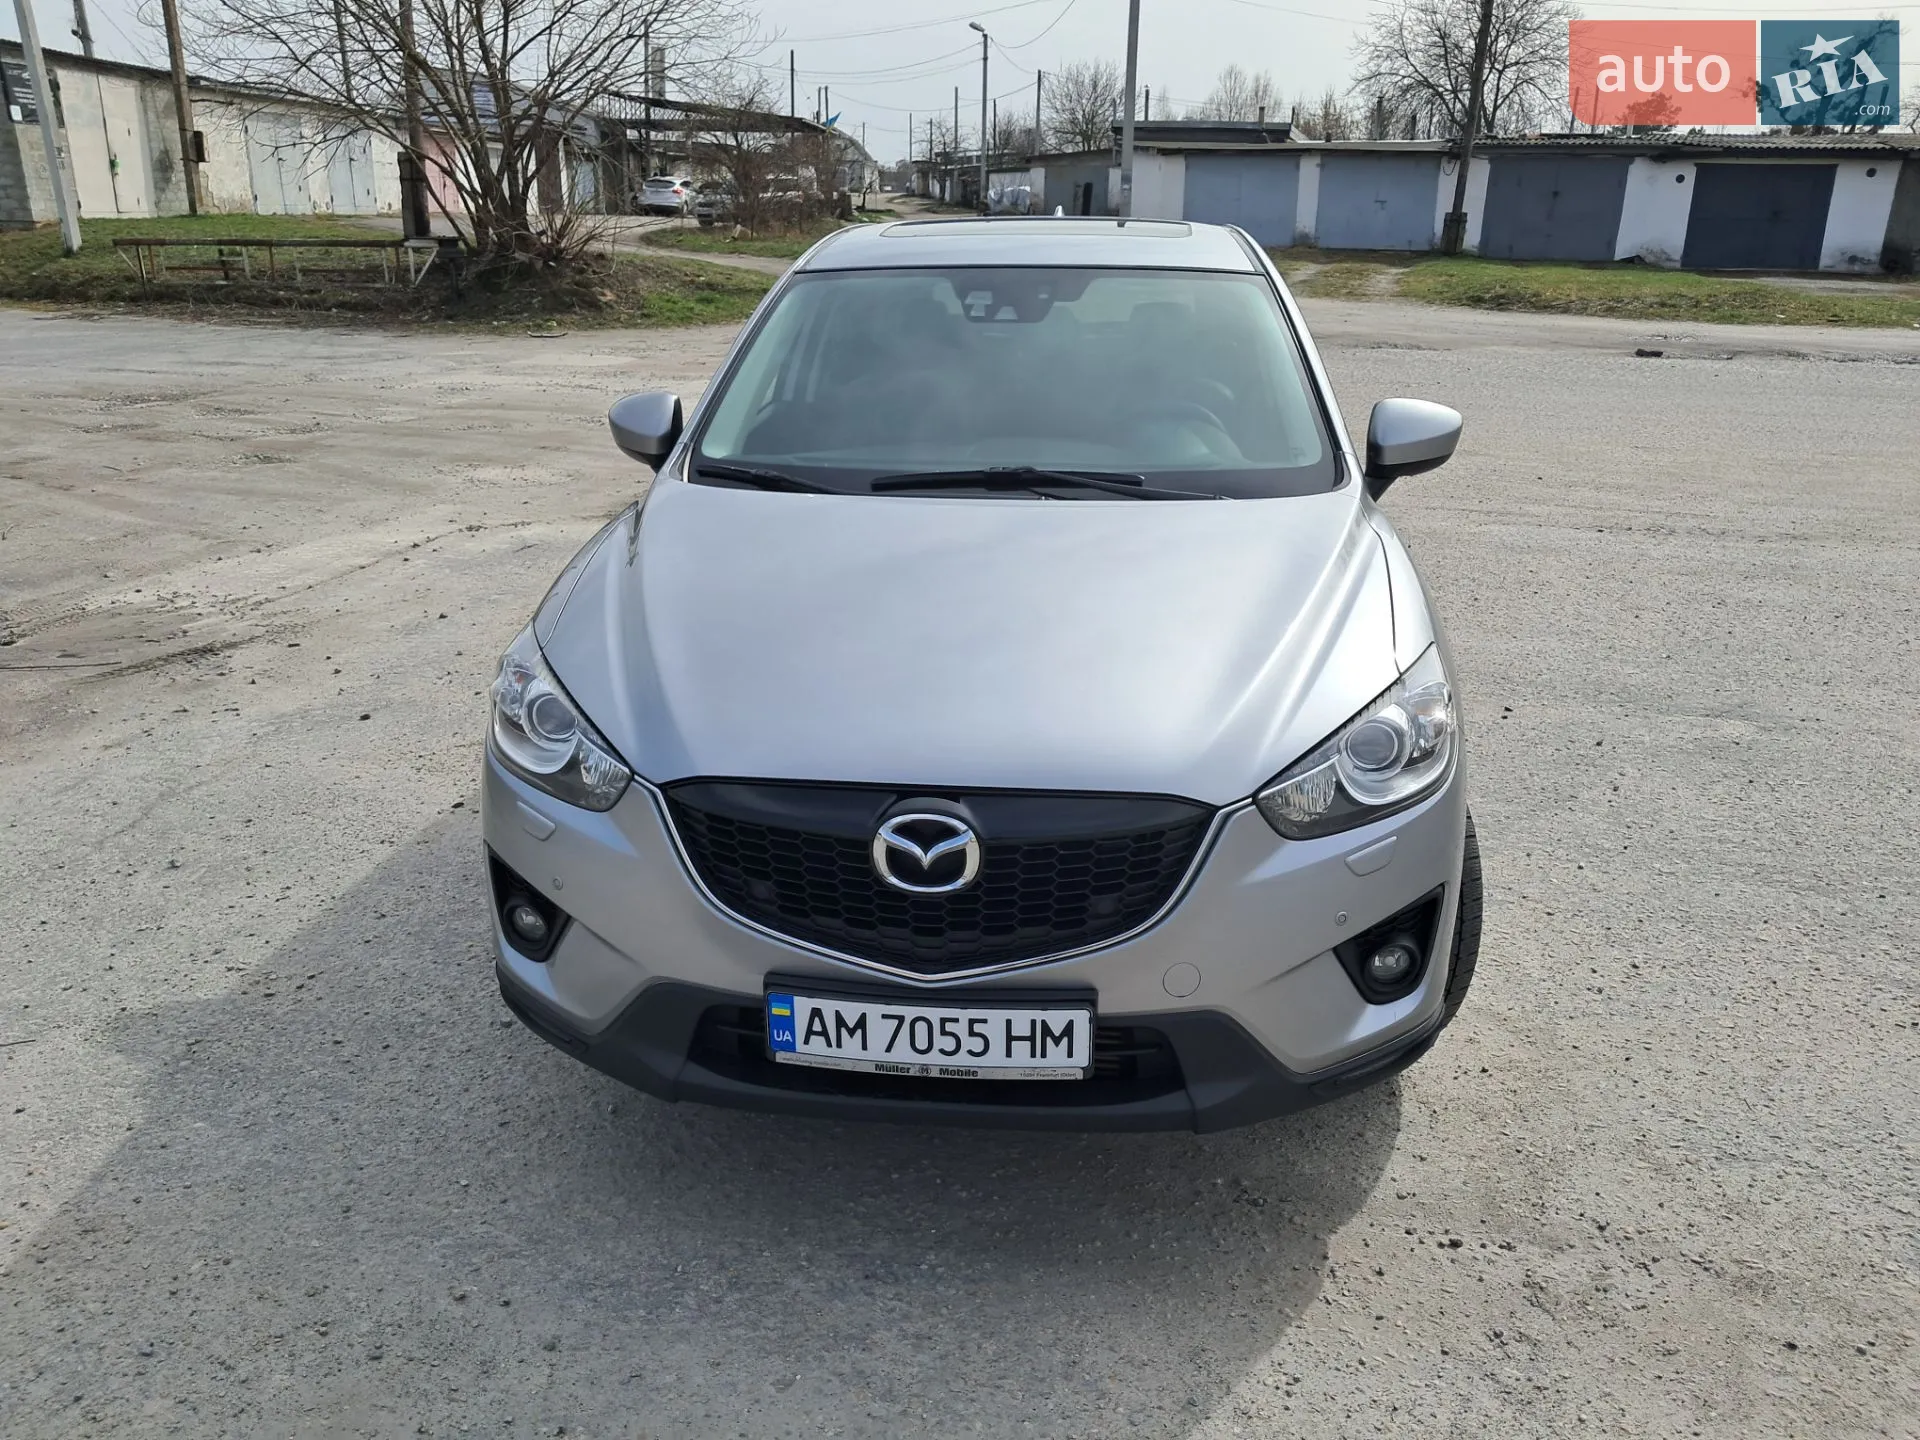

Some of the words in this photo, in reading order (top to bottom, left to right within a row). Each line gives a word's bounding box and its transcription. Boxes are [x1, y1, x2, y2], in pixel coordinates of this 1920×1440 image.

[774, 1029, 793, 1043] UA
[803, 1007, 868, 1051] AM
[881, 1013, 990, 1057] 7055
[1005, 1018, 1074, 1059] HM
[874, 1063, 912, 1074] Müller
[939, 1067, 979, 1078] Mobile
